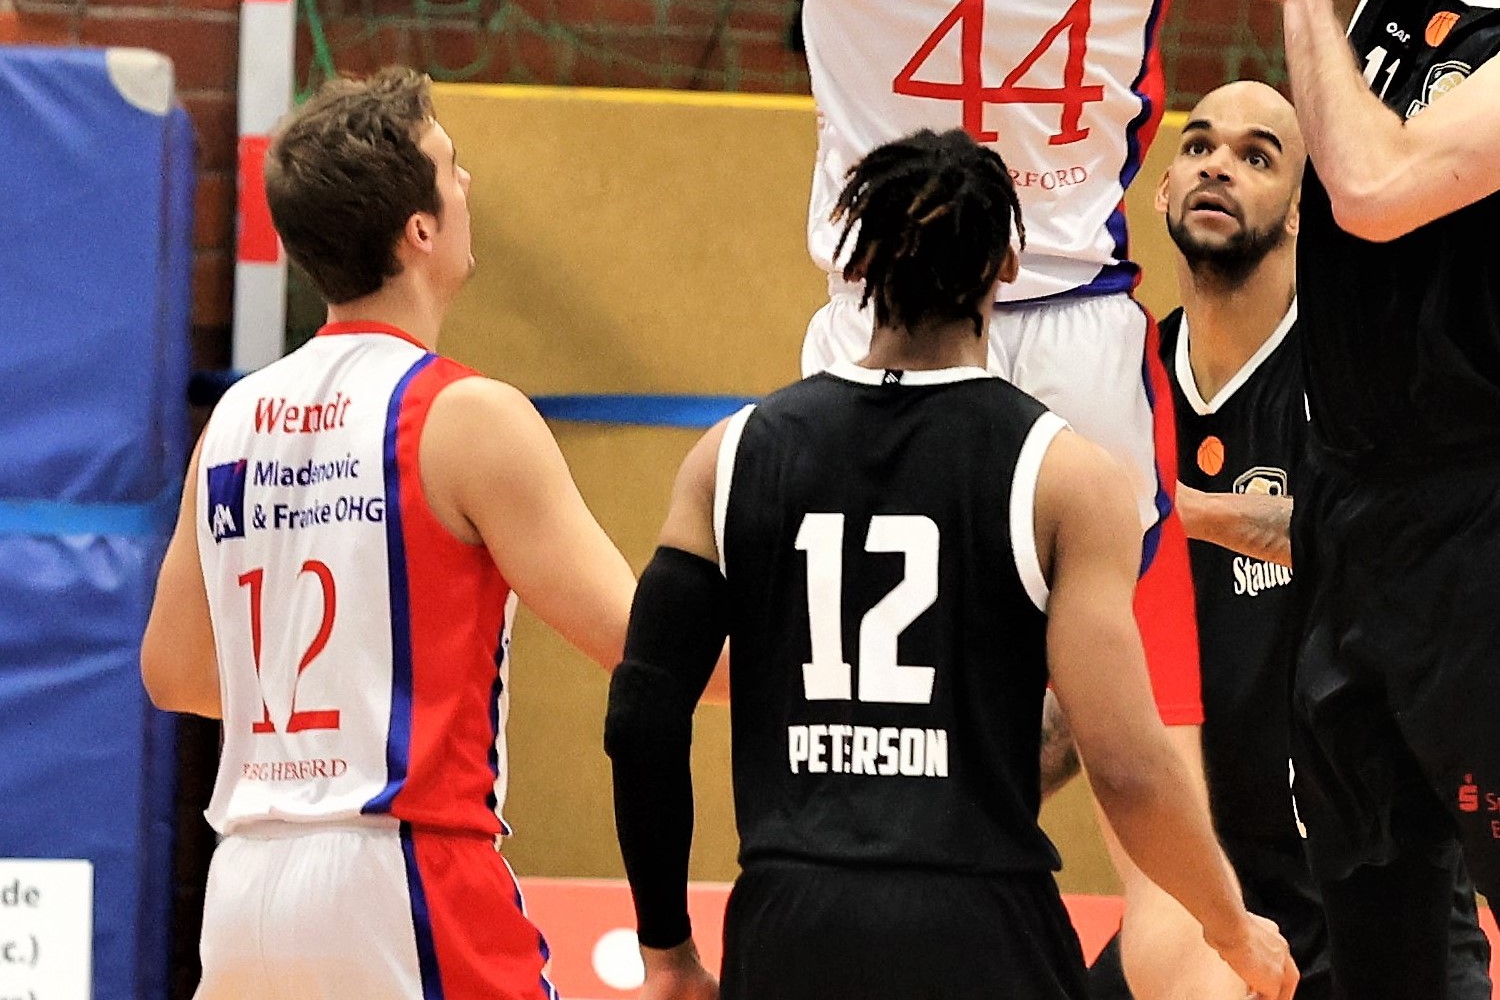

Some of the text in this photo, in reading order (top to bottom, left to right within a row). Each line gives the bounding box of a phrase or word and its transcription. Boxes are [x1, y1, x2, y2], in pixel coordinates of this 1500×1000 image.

[252, 503, 267, 530] &
[335, 496, 386, 522] OHG
[238, 560, 340, 734] 12
[794, 513, 940, 704] 12
